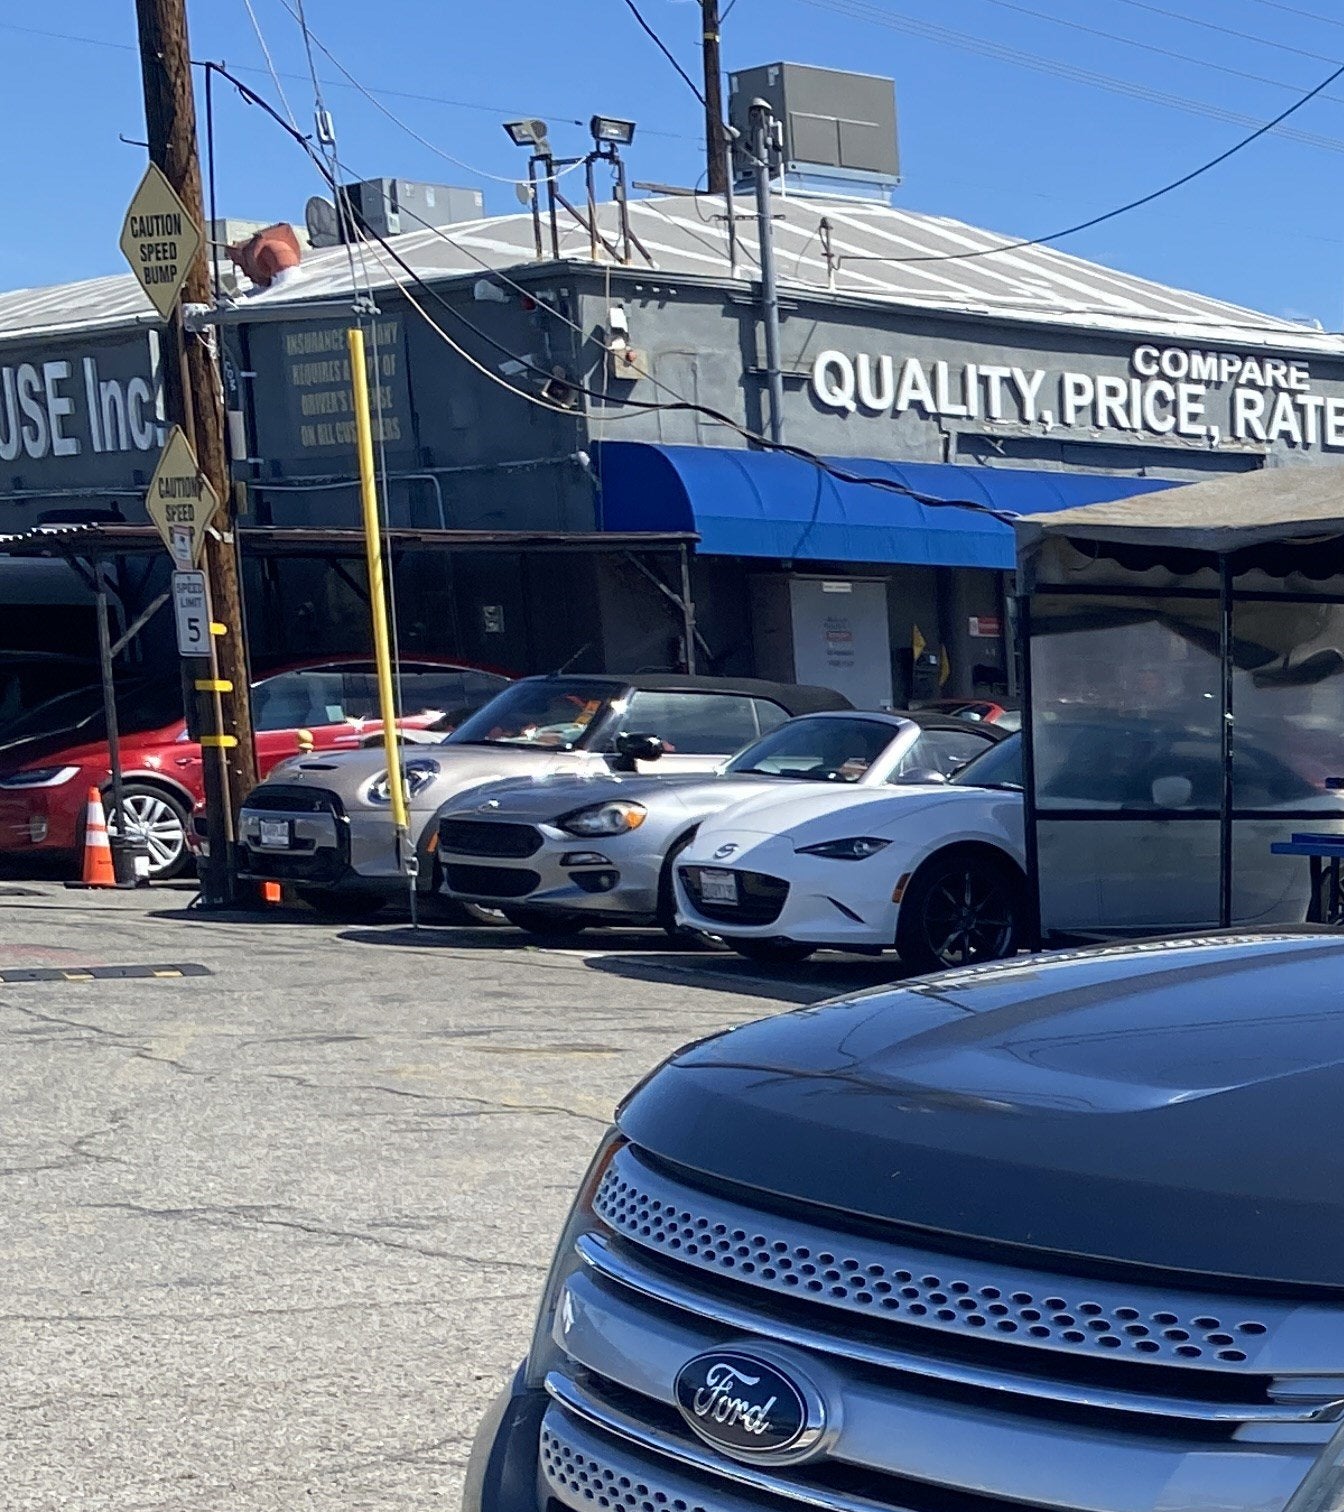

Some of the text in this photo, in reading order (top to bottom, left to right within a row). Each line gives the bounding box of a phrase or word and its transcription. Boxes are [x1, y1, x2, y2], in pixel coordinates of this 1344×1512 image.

[130, 213, 182, 239] CAUTION
[140, 241, 177, 262] SPEED
[143, 264, 178, 285] BUMP
[1132, 345, 1311, 391] COMPARE
[812, 350, 1053, 431] QUALITY,
[1062, 371, 1220, 447] PRICE,
[166, 503, 195, 522] SPEED
[176, 583, 204, 594] SPEED
[180, 596, 201, 608] LIMIT
[188, 617, 201, 643] 5
[693, 1363, 777, 1435] Ford
